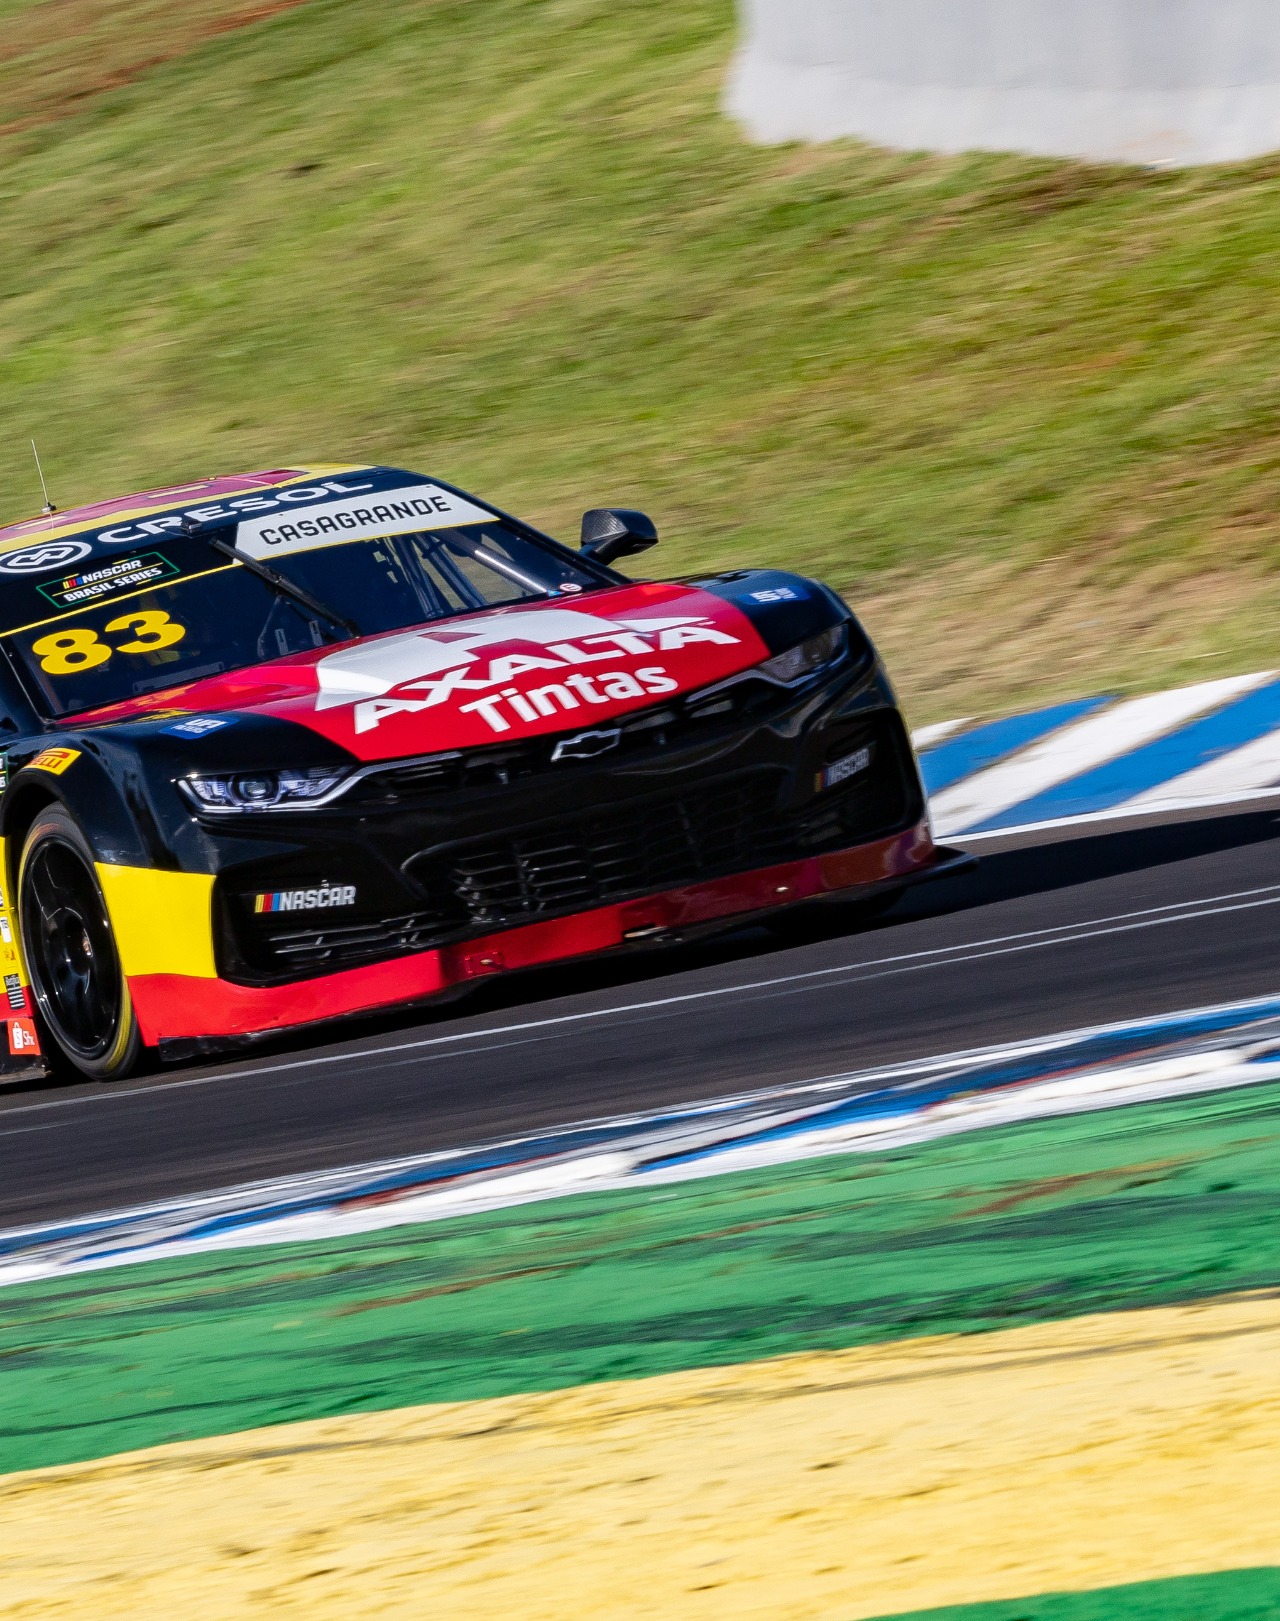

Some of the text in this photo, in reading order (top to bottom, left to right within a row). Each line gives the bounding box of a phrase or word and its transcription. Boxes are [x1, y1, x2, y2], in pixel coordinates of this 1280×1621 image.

[97, 481, 373, 543] CRESOL
[259, 495, 453, 545] CASAGRANDE
[63, 567, 163, 602] BRASIL SERIES
[81, 559, 142, 584] NASCAR
[32, 610, 186, 675] 83
[354, 626, 741, 734] AXALTA
[459, 666, 679, 733] Tintas
[279, 886, 356, 911] NASCAR
